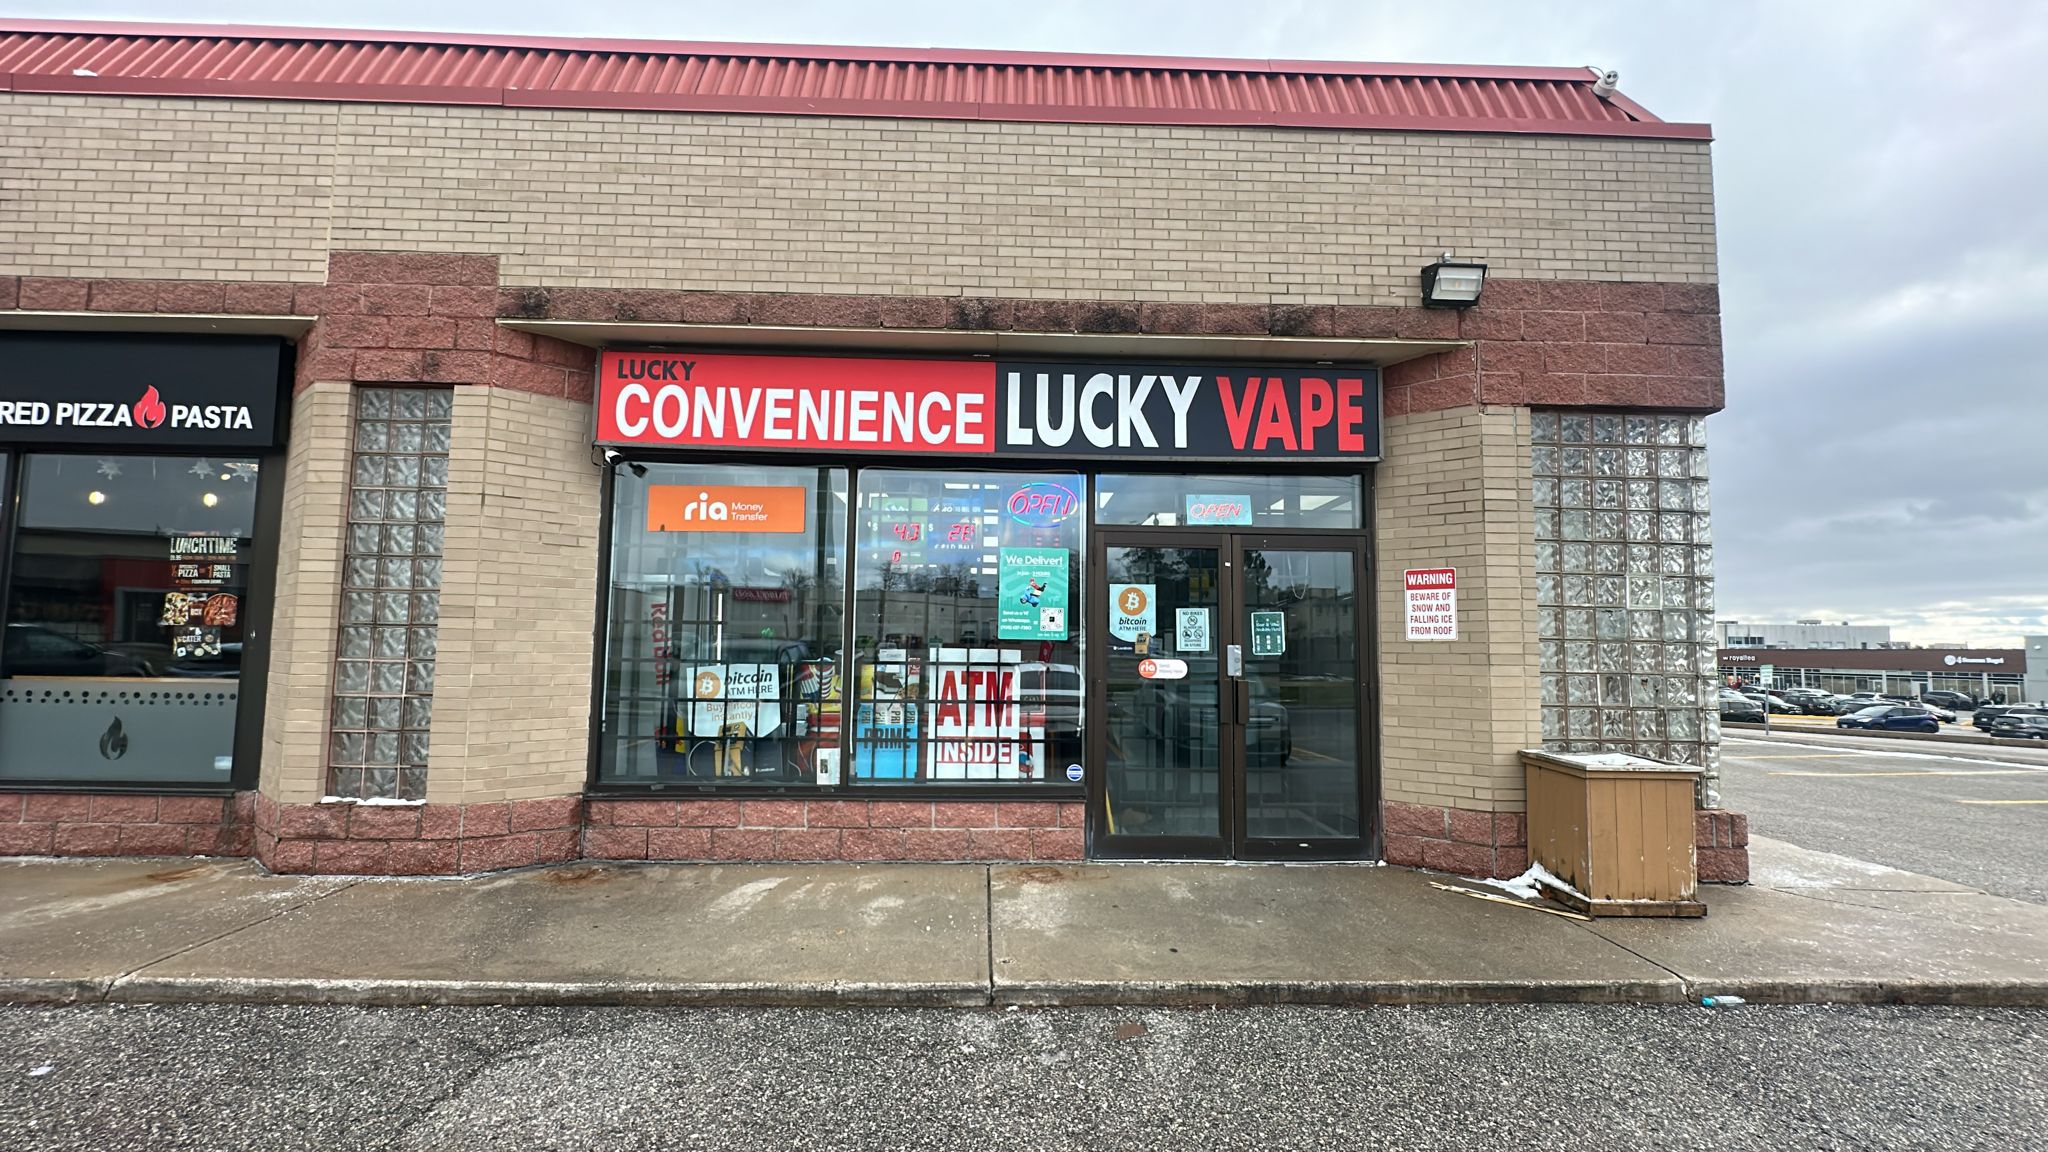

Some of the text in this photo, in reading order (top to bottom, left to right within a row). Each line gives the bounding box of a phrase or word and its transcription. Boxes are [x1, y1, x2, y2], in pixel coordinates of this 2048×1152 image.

[618, 359, 696, 380] LUCKY
[56, 403, 132, 427] PIZZA
[171, 405, 253, 429] PASTA
[615, 383, 984, 445] CONVENIENCE
[1007, 373, 1365, 452] LUCKY VAPE
[684, 491, 728, 521] ria
[731, 502, 763, 516] Money
[1190, 503, 1243, 518] OPEN
[731, 512, 768, 521] Transfer
[170, 538, 237, 553] LUNCHTIME
[1006, 555, 1063, 566] We Deliver!
[178, 569, 198, 577] PIZZA
[1407, 573, 1453, 585] WARNING
[1410, 592, 1452, 601] BEWARE OF
[1411, 604, 1450, 612] SNOW AND
[1119, 617, 1147, 625] bitcoin
[1410, 615, 1453, 624] FALLING ICE
[1411, 626, 1453, 635] FROM ROOF
[1140, 661, 1156, 672] ria
[937, 671, 1013, 727] ATM
[706, 703, 724, 712] Buy
[864, 727, 911, 749] PRIME
[937, 741, 1010, 763] INSIDE
